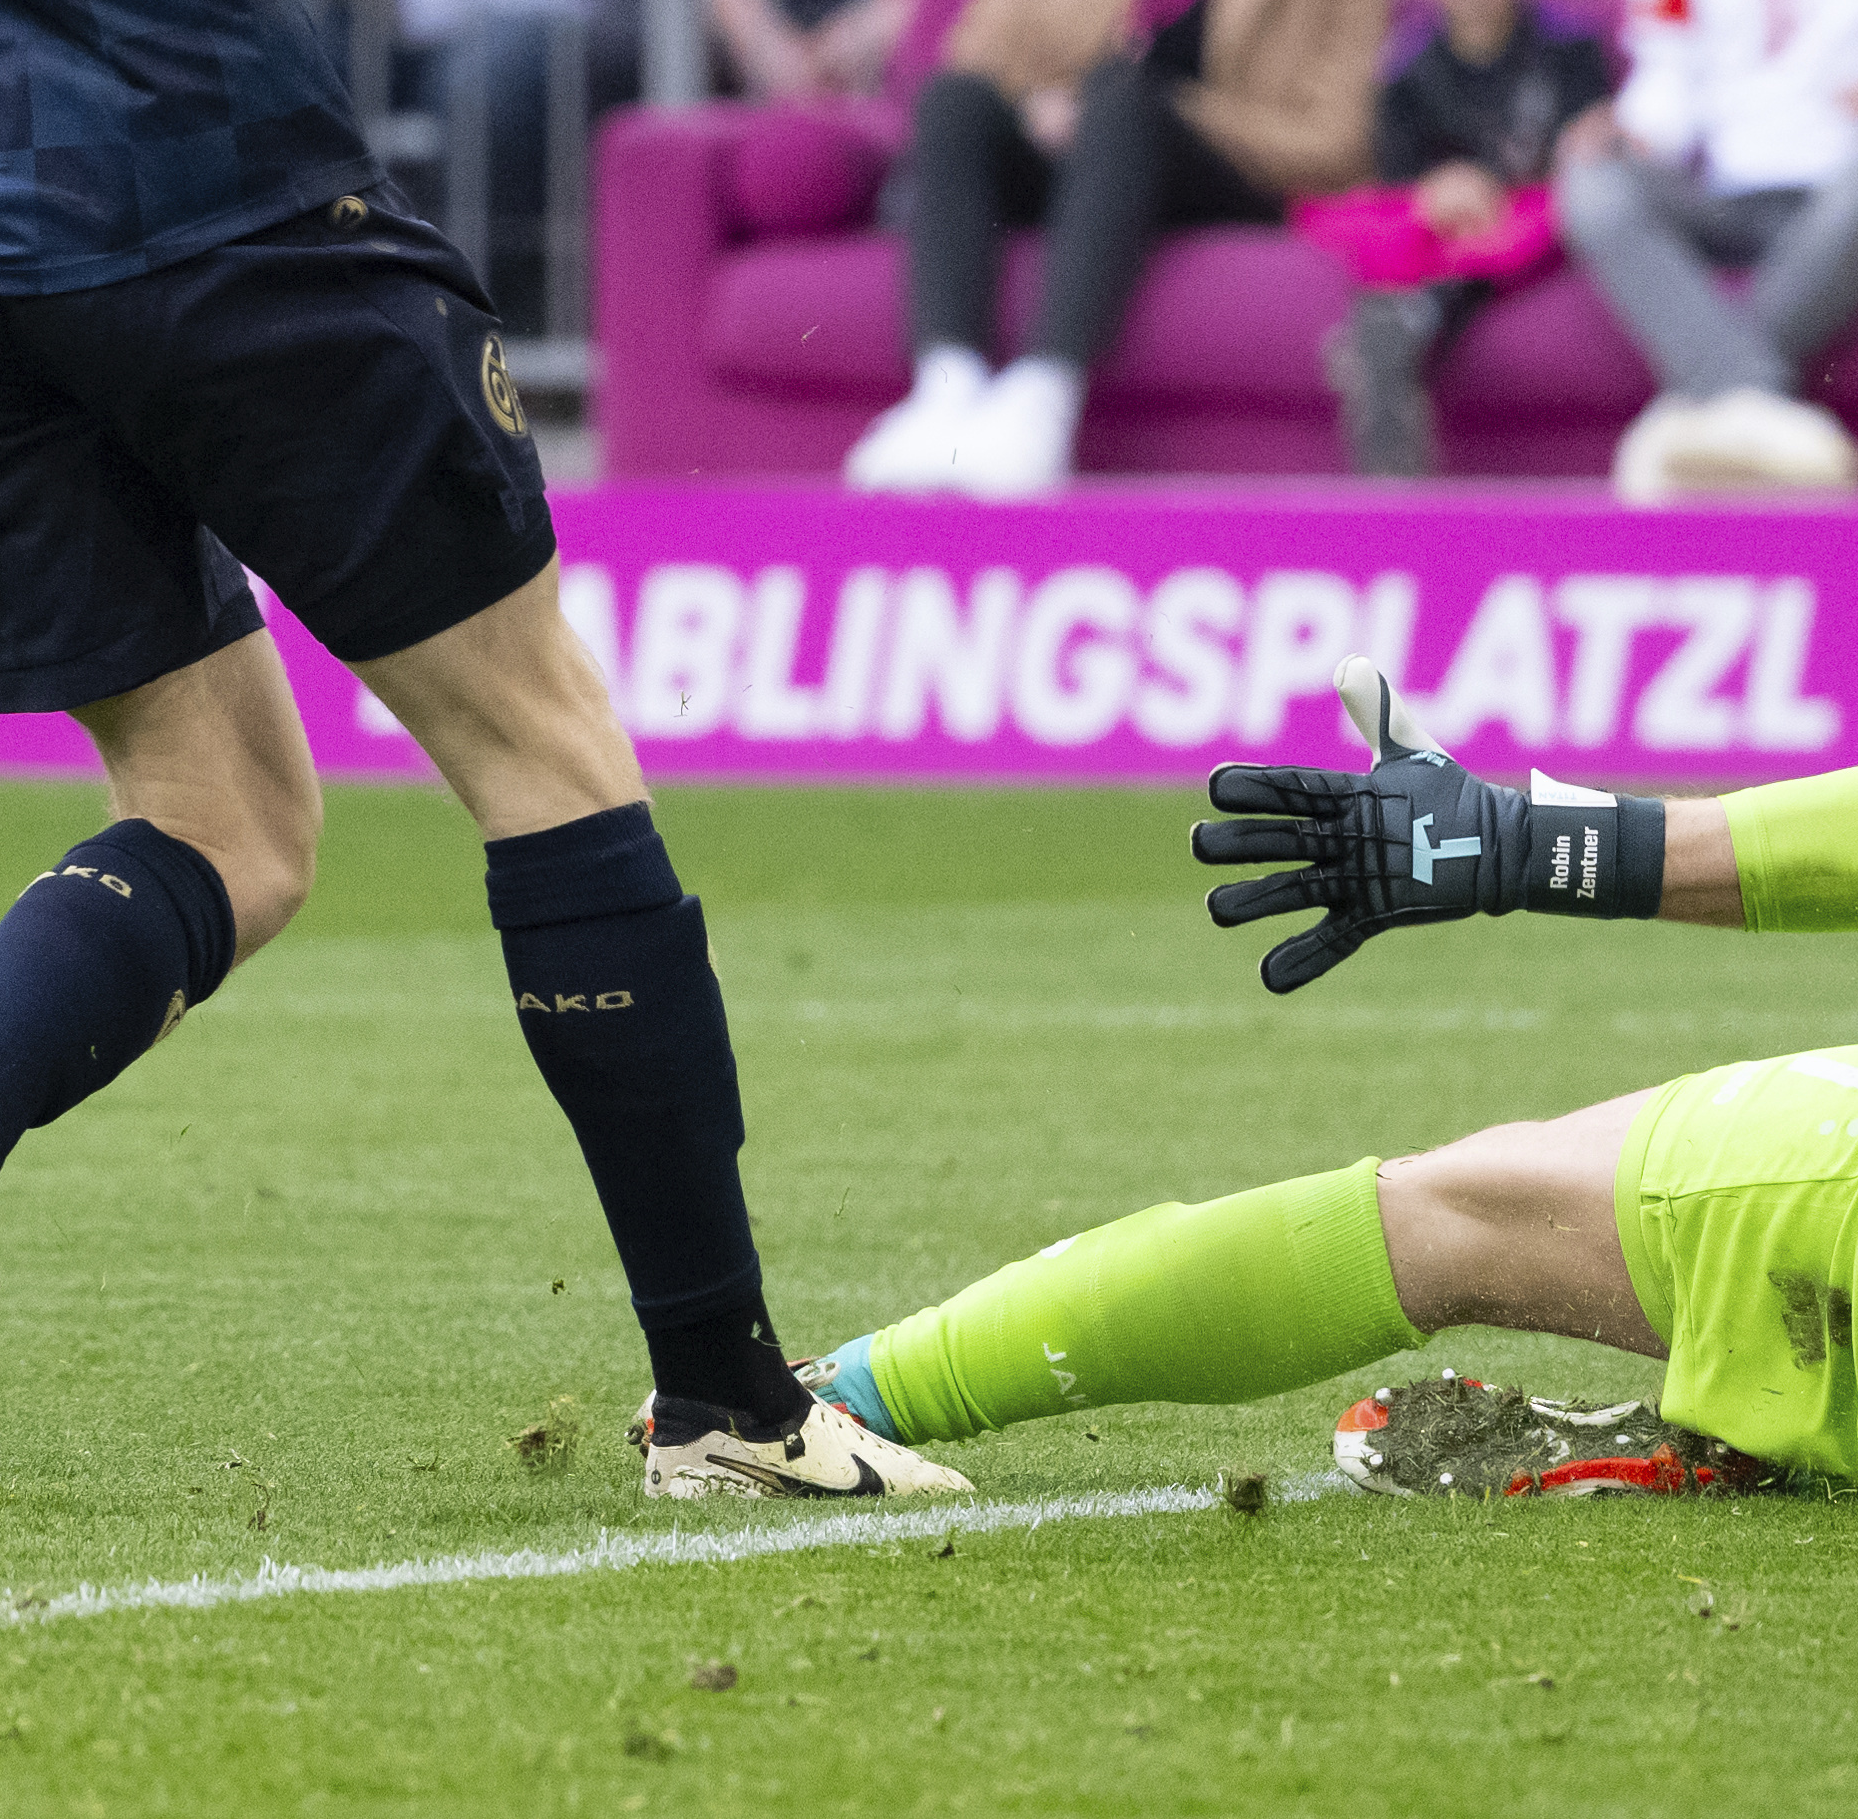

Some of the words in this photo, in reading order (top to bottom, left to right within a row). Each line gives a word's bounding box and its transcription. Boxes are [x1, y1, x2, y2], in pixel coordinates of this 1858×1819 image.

[355, 562, 1842, 754] BLINGSPLATZL
[17, 865, 133, 899] KO
[1549, 835, 1571, 889] Robin
[1576, 826, 1599, 899] Zentner
[516, 990, 635, 1013] AKO
